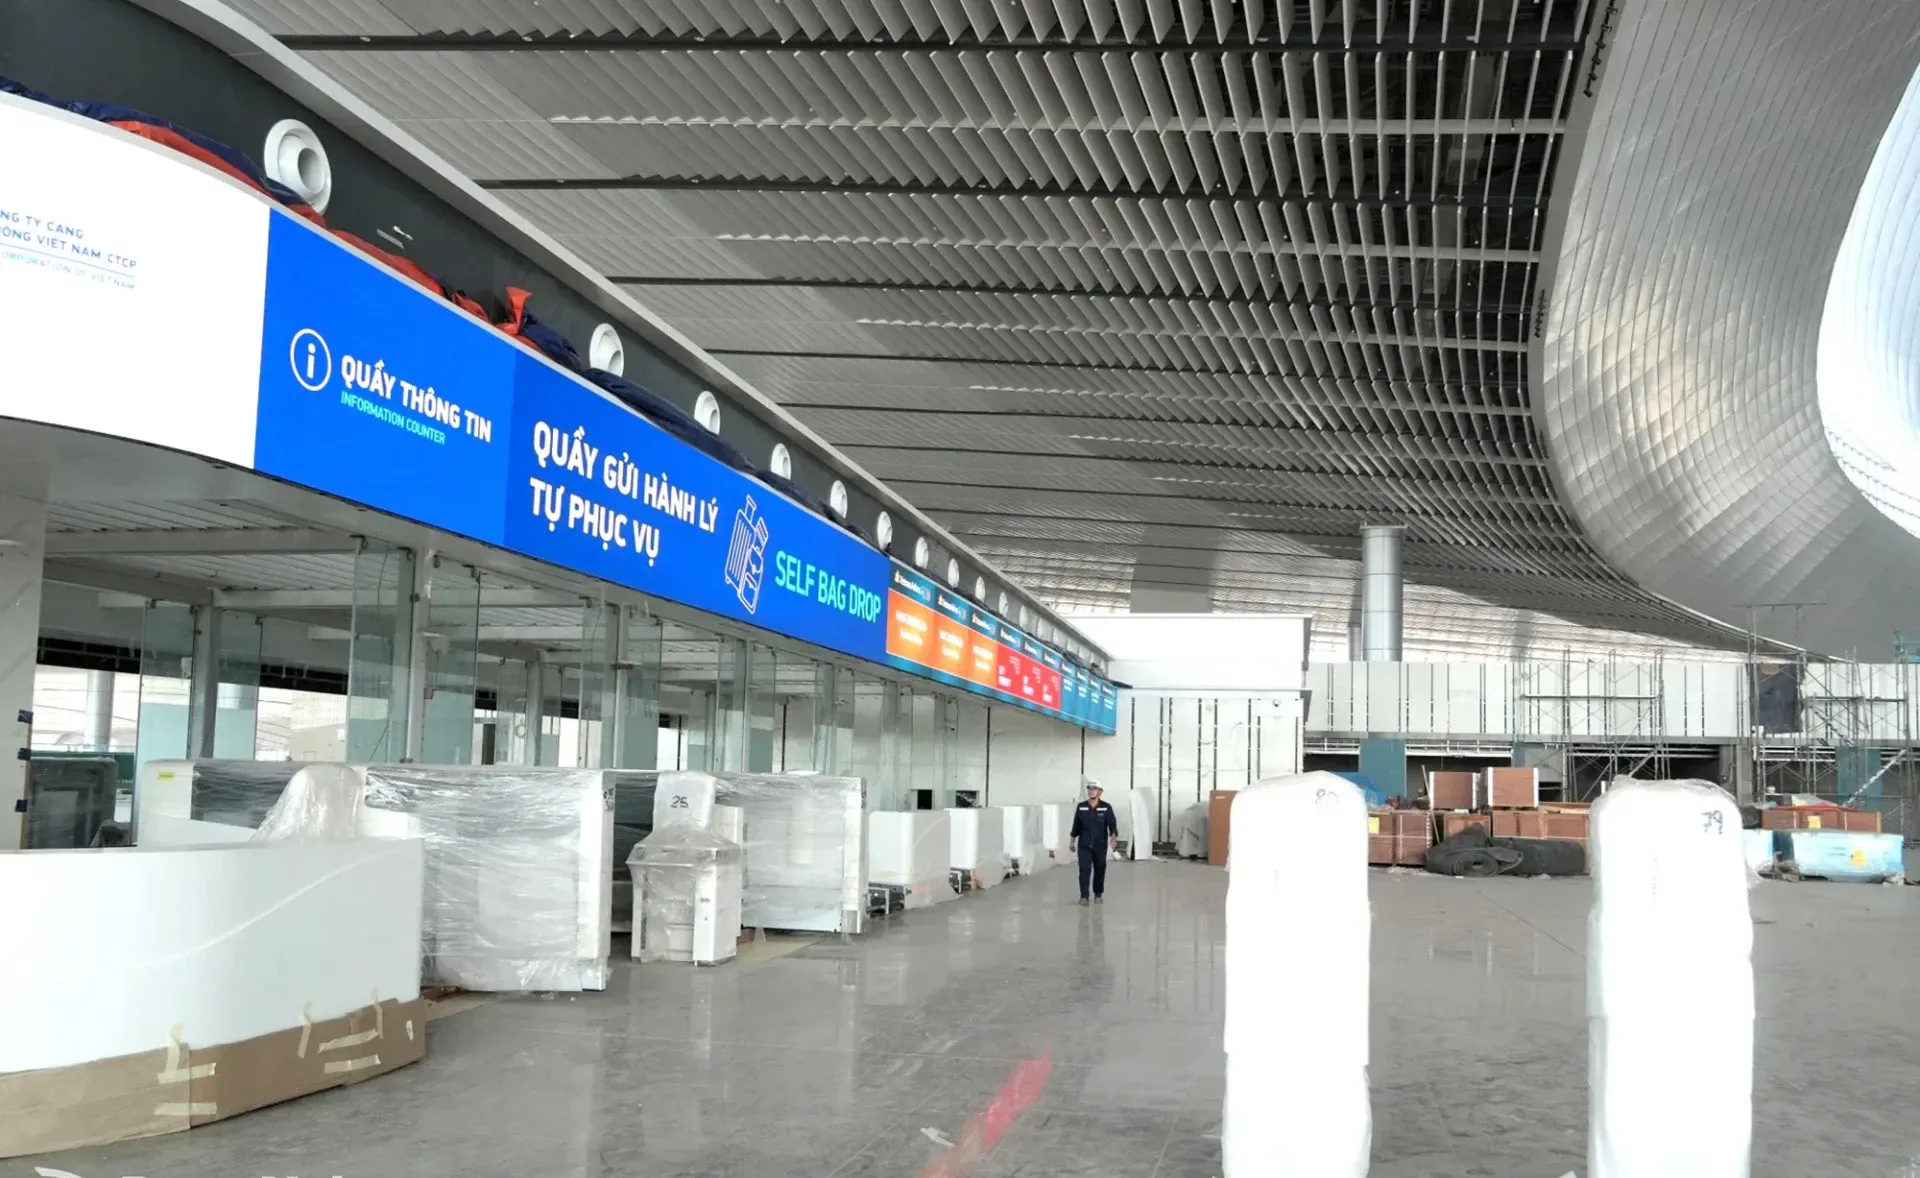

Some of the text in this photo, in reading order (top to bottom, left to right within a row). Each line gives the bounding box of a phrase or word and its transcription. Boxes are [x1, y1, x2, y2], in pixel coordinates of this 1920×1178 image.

[25, 215, 42, 228] TY
[71, 243, 101, 259] NAM
[107, 253, 137, 268] CTCP
[340, 391, 446, 445] INFORMATION COUNTER
[341, 354, 492, 443] QUẦY THÔNG TIN
[533, 420, 719, 534] QUẦY GỬI HÀNH LÝ
[529, 477, 661, 567] TỰ PHỤC VỤ
[775, 550, 815, 595] SELF
[818, 569, 847, 611] BAG
[849, 584, 882, 624] DROP
[670, 795, 689, 808] 25
[1699, 809, 1723, 835] 79
